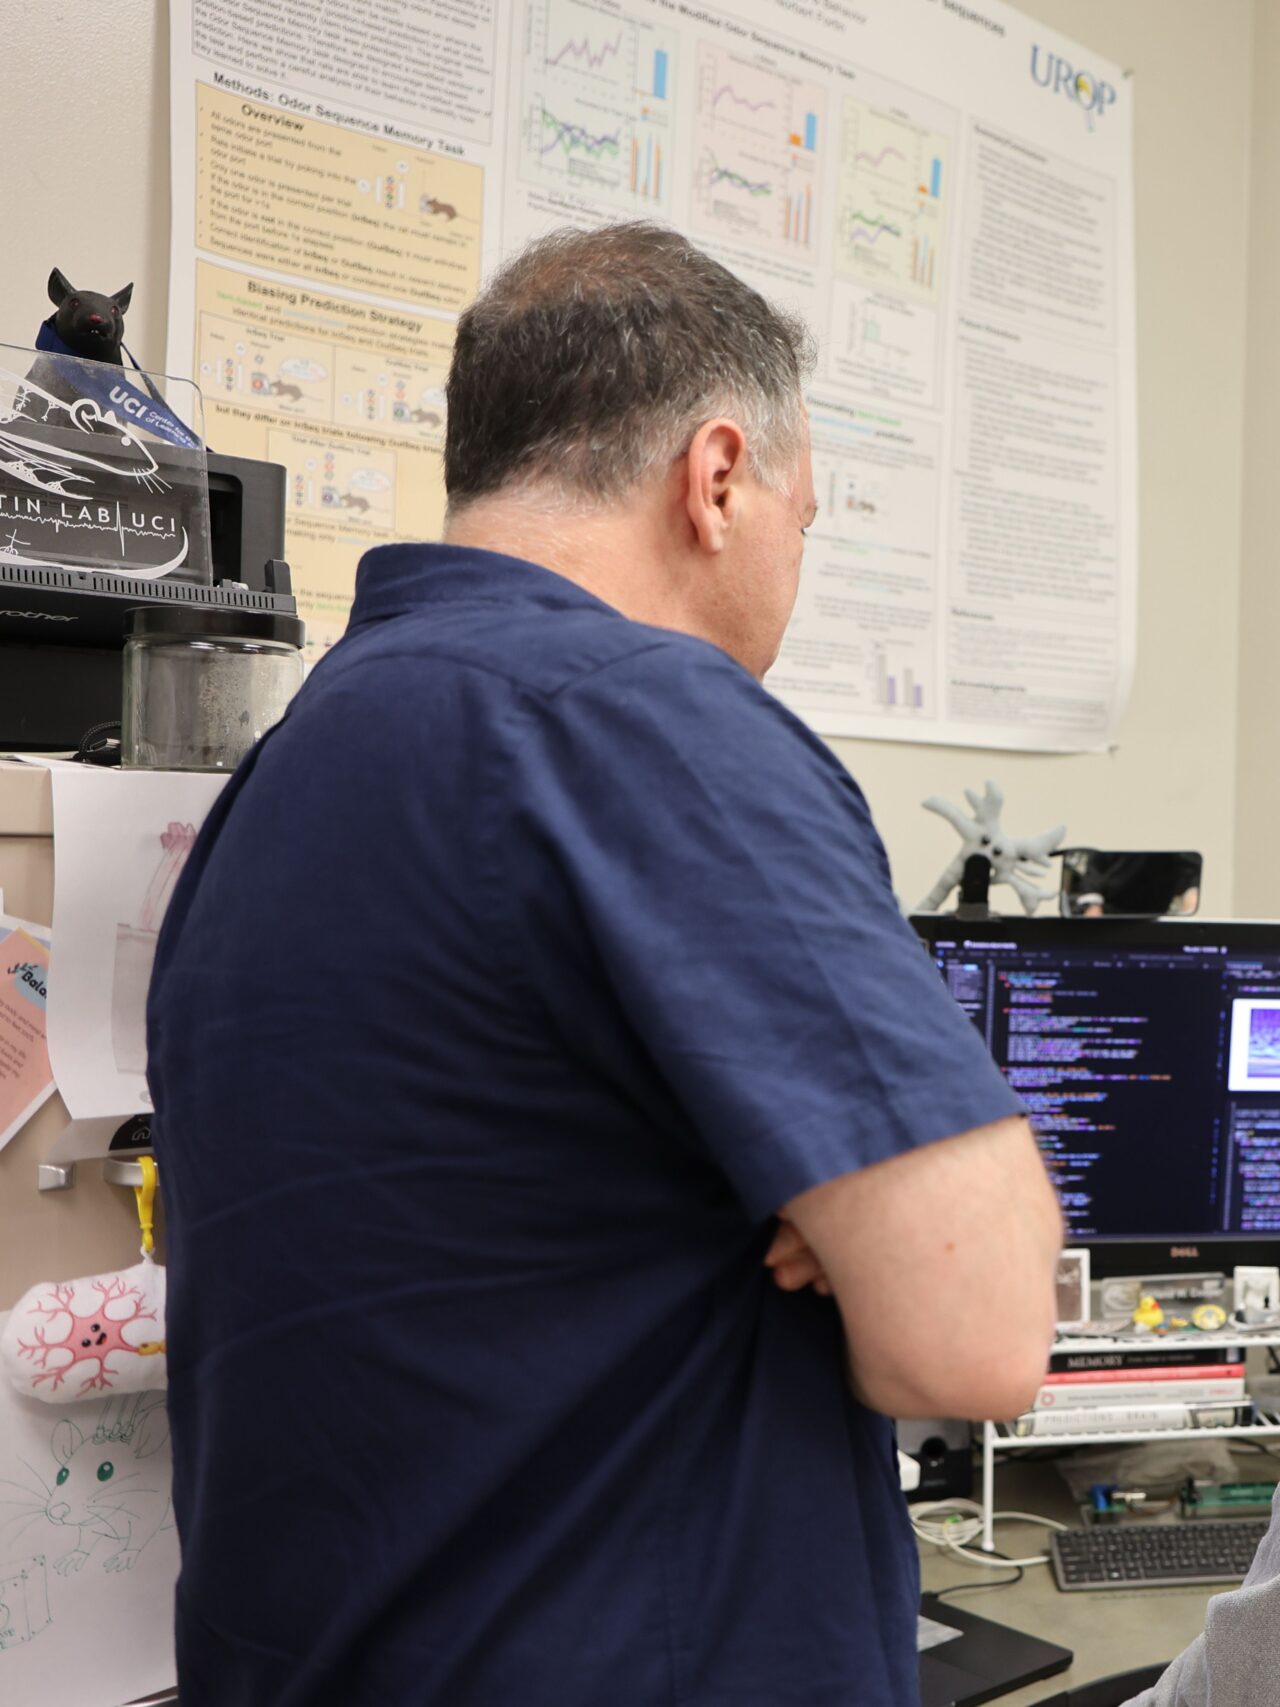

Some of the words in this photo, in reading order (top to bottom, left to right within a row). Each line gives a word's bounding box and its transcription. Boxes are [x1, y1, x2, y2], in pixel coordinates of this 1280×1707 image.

[1029, 43, 1117, 122] UROP
[213, 71, 274, 103] Methods:
[277, 93, 312, 113] Odor
[315, 104, 379, 134] Sequence
[383, 123, 435, 150] Memory
[438, 138, 466, 157] Task
[240, 103, 305, 132] Overview
[265, 128, 305, 147] presented
[248, 281, 297, 306] Biasing
[301, 294, 366, 320] Prediction
[369, 310, 424, 333] Strategy
[109, 386, 147, 419] UCI
[0, 494, 41, 514] TIN
[61, 503, 110, 523] LAB
[132, 512, 176, 532] UCI
[1170, 1246, 1200, 1258] DELL
[1067, 1354, 1125, 1369] MEMORY
